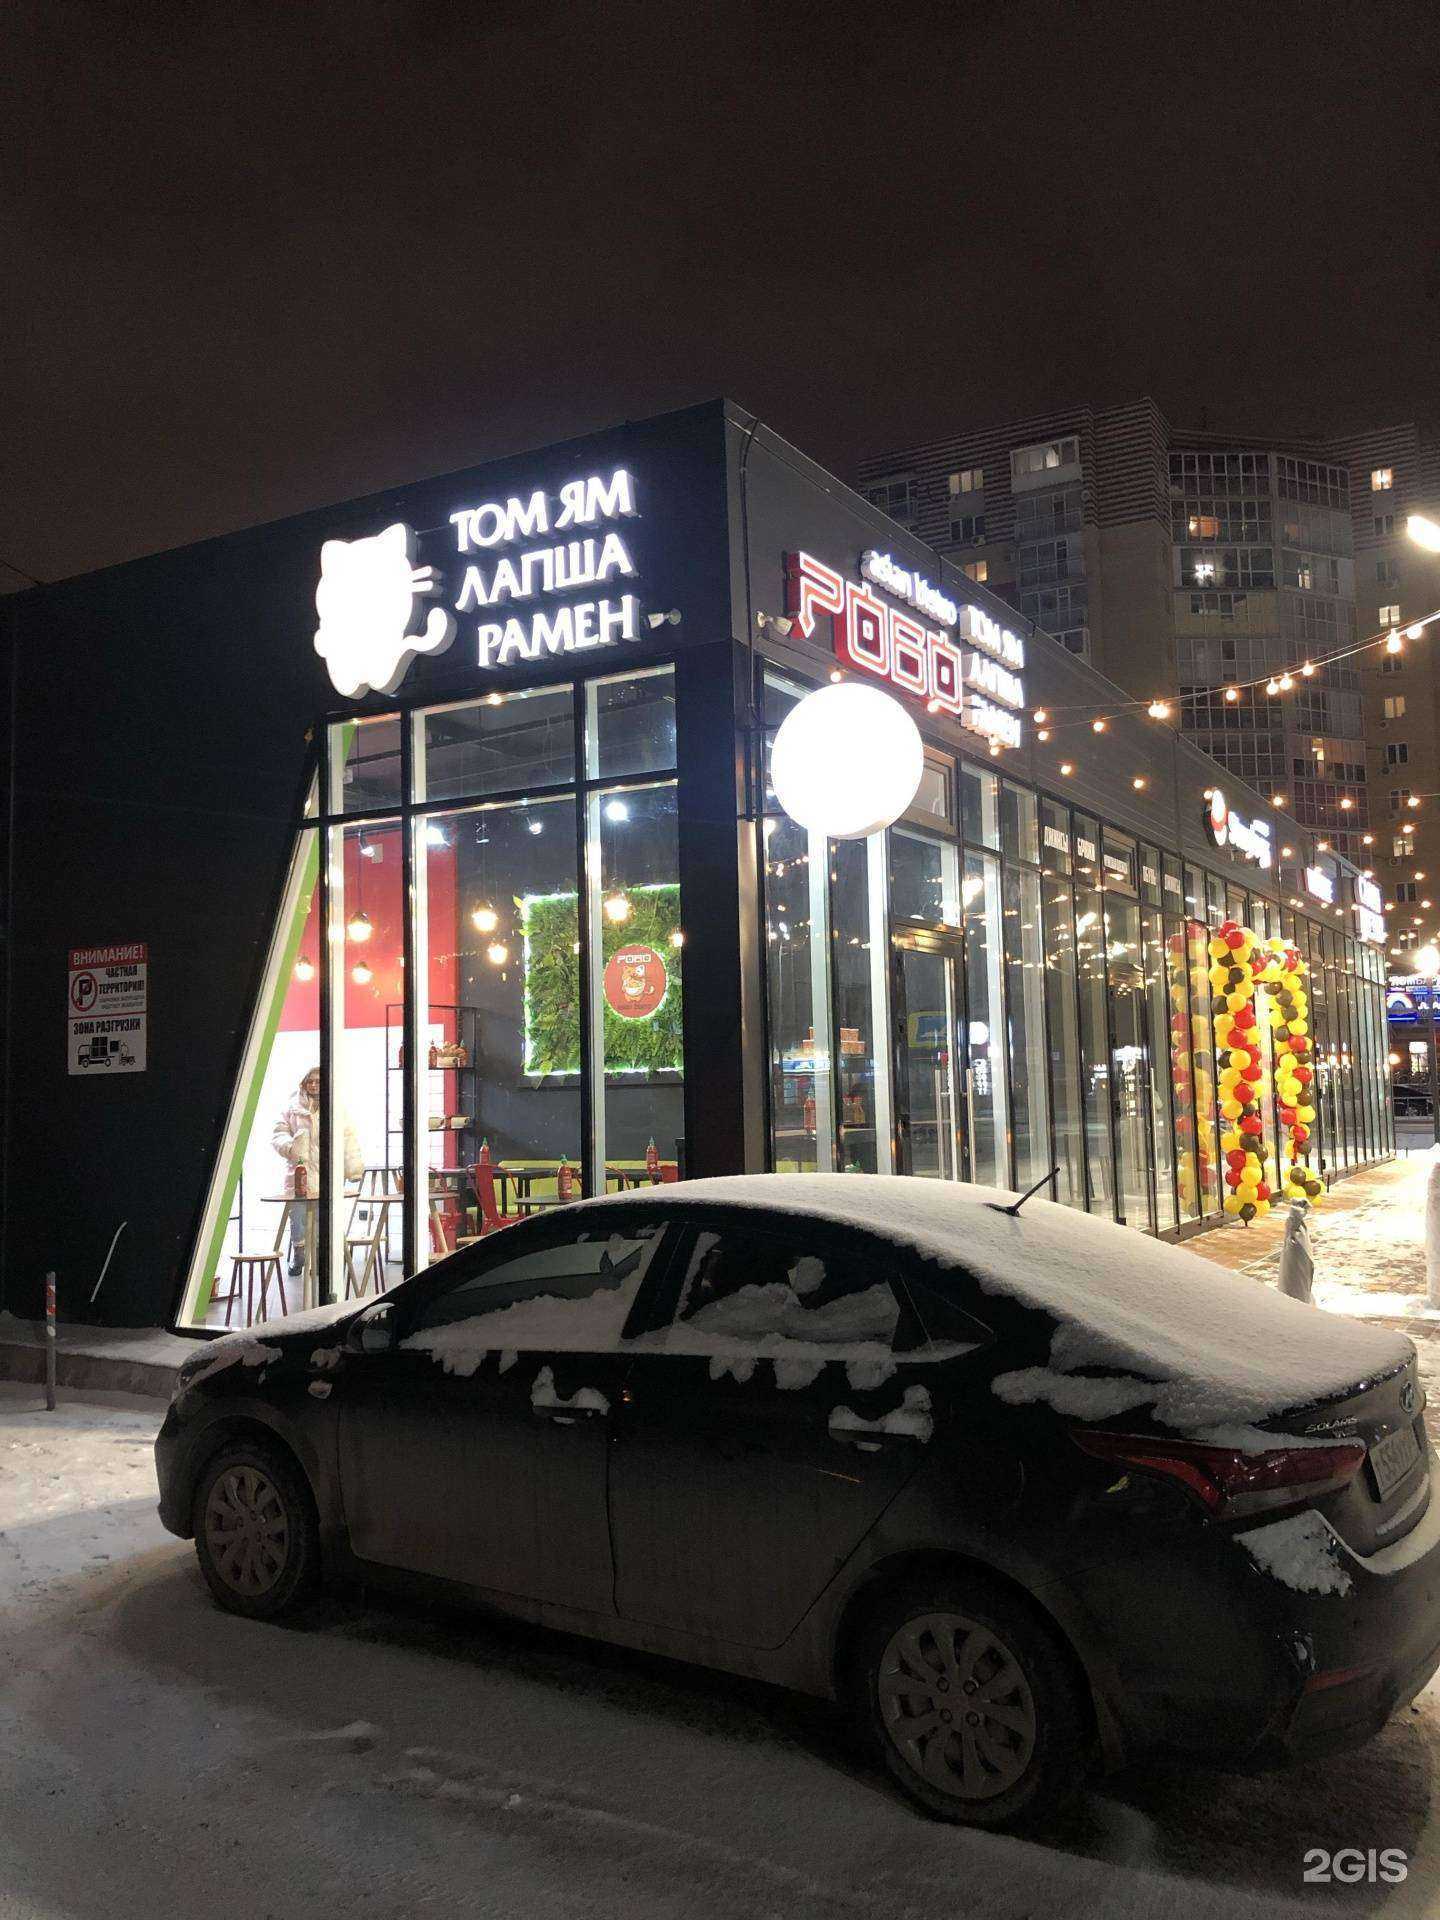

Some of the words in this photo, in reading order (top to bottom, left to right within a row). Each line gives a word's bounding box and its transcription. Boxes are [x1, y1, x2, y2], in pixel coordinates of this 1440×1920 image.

[449, 490, 551, 554] ТОМ
[555, 468, 638, 529] ЯМ
[455, 533, 639, 613] ЛАПША
[476, 594, 641, 670] РАМЕН
[73, 945, 143, 966] ВНИМАНИЕ!
[73, 1021, 95, 1036] ЗОНА
[96, 1018, 141, 1034] РАЗГРУЗКИ
